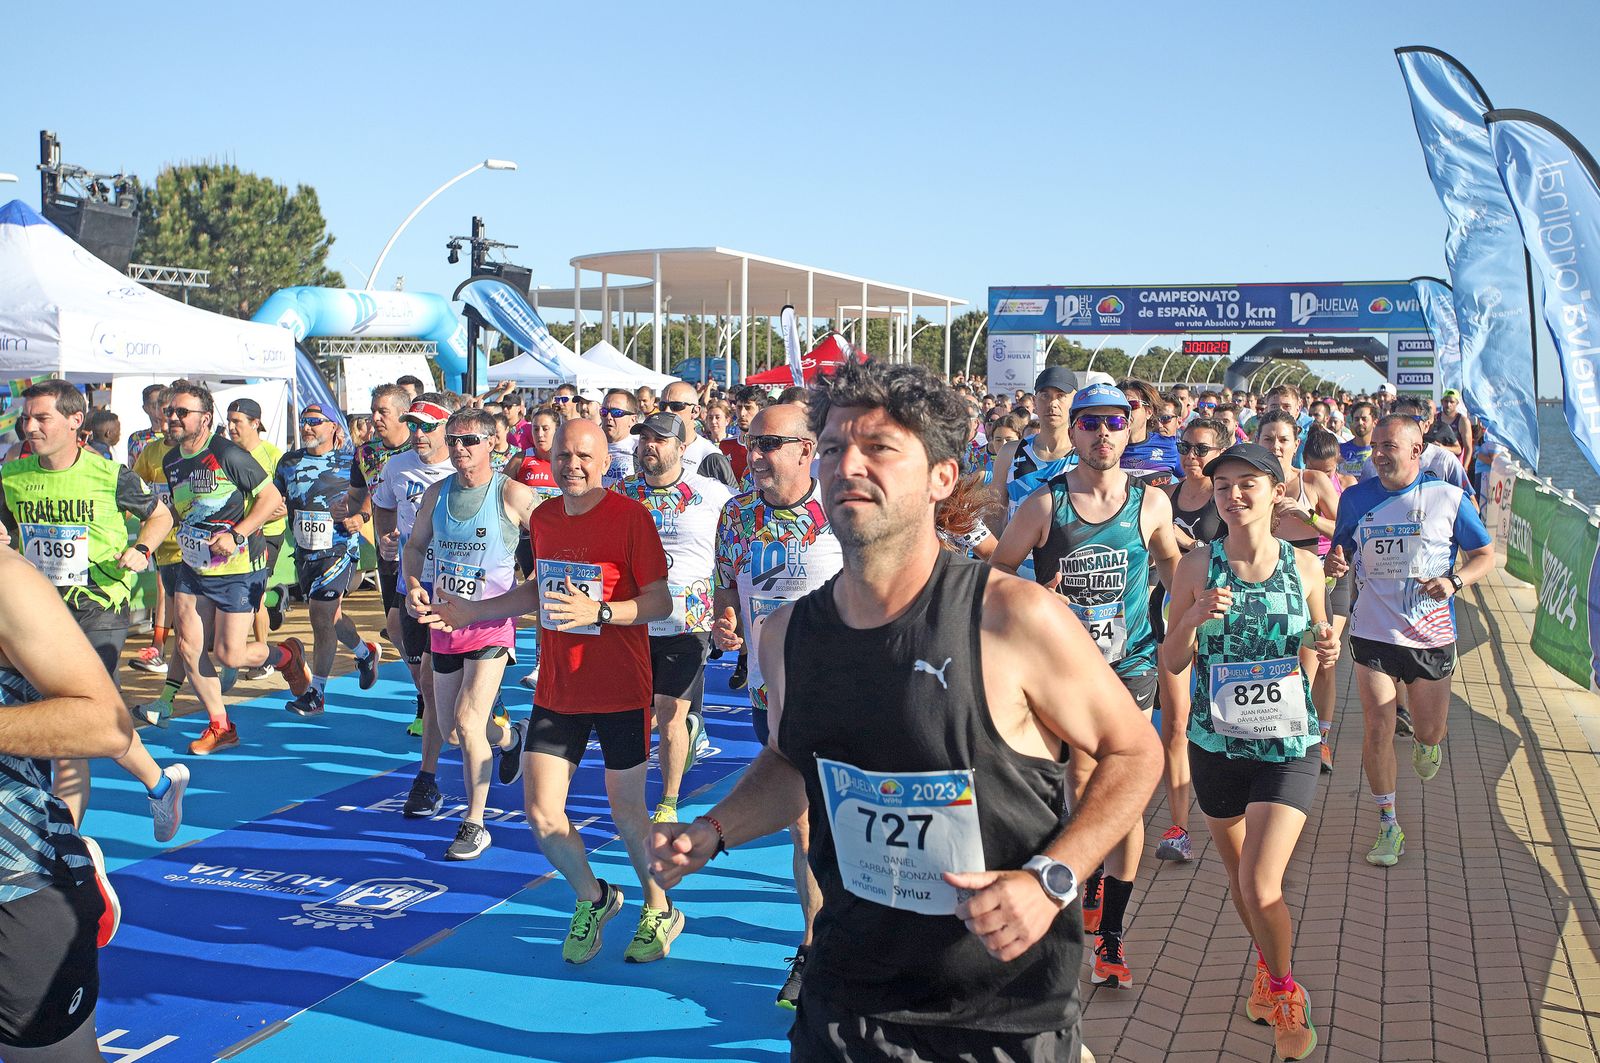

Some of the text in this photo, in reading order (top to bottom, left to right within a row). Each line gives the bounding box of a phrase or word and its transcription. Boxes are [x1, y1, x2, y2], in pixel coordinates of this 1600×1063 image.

[1139, 290, 1240, 303] CAMPEONATO
[1055, 295, 1079, 326] 10
[1138, 303, 1276, 319] de ESPAÑA 10 km
[1290, 292, 1359, 325] 10 HUELVA
[1248, 319, 1276, 327] Master
[525, 471, 549, 480] Santa
[299, 521, 326, 533] 1850
[1397, 526, 1415, 535] 2023
[34, 540, 76, 559] 1369
[439, 541, 486, 551] TARTESSOS
[787, 541, 808, 553] HU
[1375, 538, 1404, 554] 571
[787, 553, 807, 565] EL
[1062, 551, 1126, 573] MONSARAZ
[577, 567, 595, 579] 2023
[787, 565, 807, 577] VA
[441, 575, 477, 596] 1029
[1066, 574, 1121, 588] NATUR TRAIL
[1099, 607, 1118, 618] 2023
[1268, 663, 1292, 676] 2023
[1234, 682, 1282, 706] 826
[1253, 724, 1278, 734] Syrluz
[911, 781, 958, 801] 2023
[857, 806, 934, 851] 727
[859, 860, 898, 877] CARBAJO
[883, 855, 917, 869] DANIEL
[163, 873, 190, 887] de
[188, 862, 343, 889] HUELVA
[190, 874, 316, 896] Ayuntamiento
[893, 885, 931, 900] Syrluz
